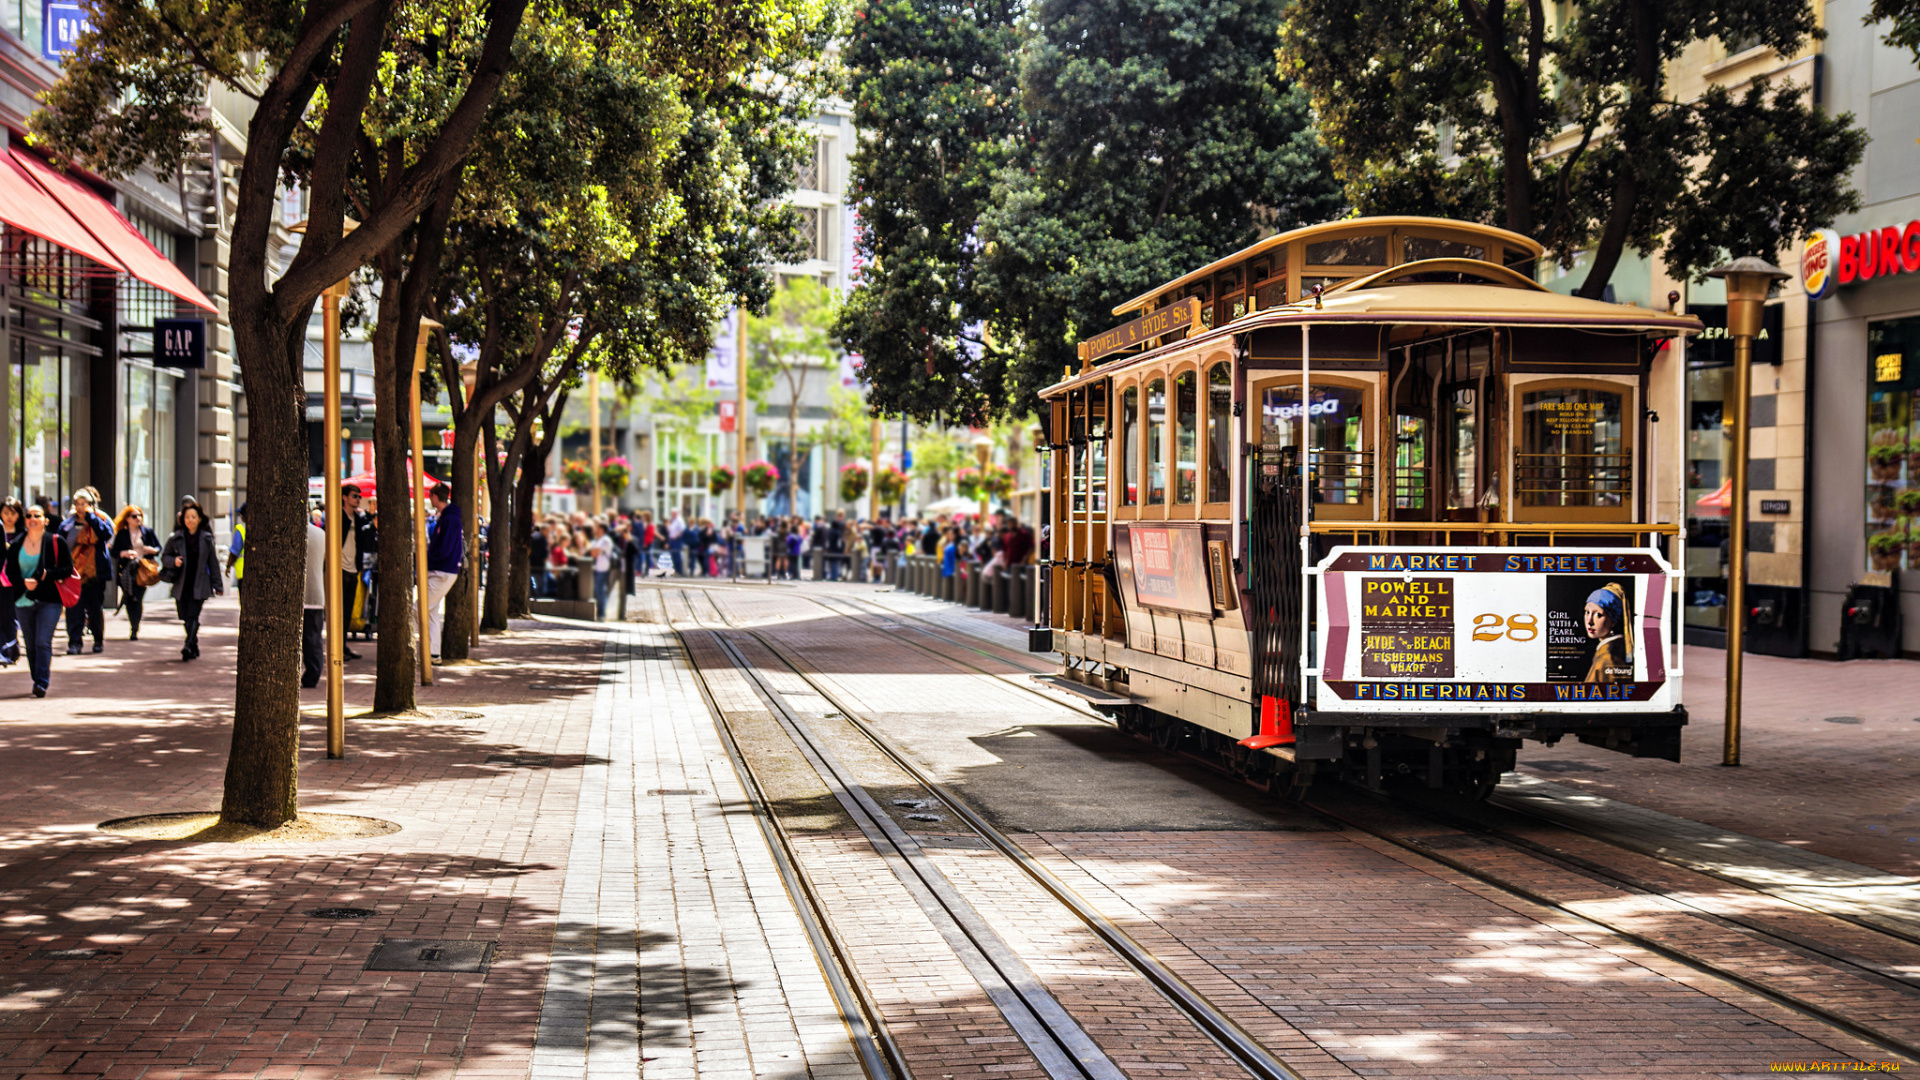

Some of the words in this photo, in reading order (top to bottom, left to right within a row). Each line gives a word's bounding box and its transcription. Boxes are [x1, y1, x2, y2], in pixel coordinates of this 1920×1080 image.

[1803, 252, 1828, 281] KING
[165, 329, 192, 351] GAP
[1090, 331, 1124, 355] POWELL
[1129, 325, 1137, 341] &
[1141, 312, 1169, 337] HYDE
[1875, 353, 1902, 368] OPEN
[1540, 403, 1556, 411] FARE
[1574, 402, 1589, 411] ONE
[1368, 554, 1477, 571] MARKET
[1505, 555, 1604, 572] STREET
[1367, 581, 1449, 594] POWELL
[1388, 595, 1429, 604] AND
[1365, 605, 1450, 617] MARKET
[1548, 610, 1570, 619] GIRL
[1472, 613, 1538, 642] 28
[1549, 627, 1575, 635] PEARL
[1367, 636, 1395, 650] HYDE
[1413, 636, 1451, 650] BEACH
[1374, 652, 1443, 662] FISHERMANS
[1390, 663, 1426, 672] WHARF
[1605, 667, 1614, 675] de
[1354, 683, 1527, 700] FISHERMANS
[1554, 684, 1636, 700] WHARF
